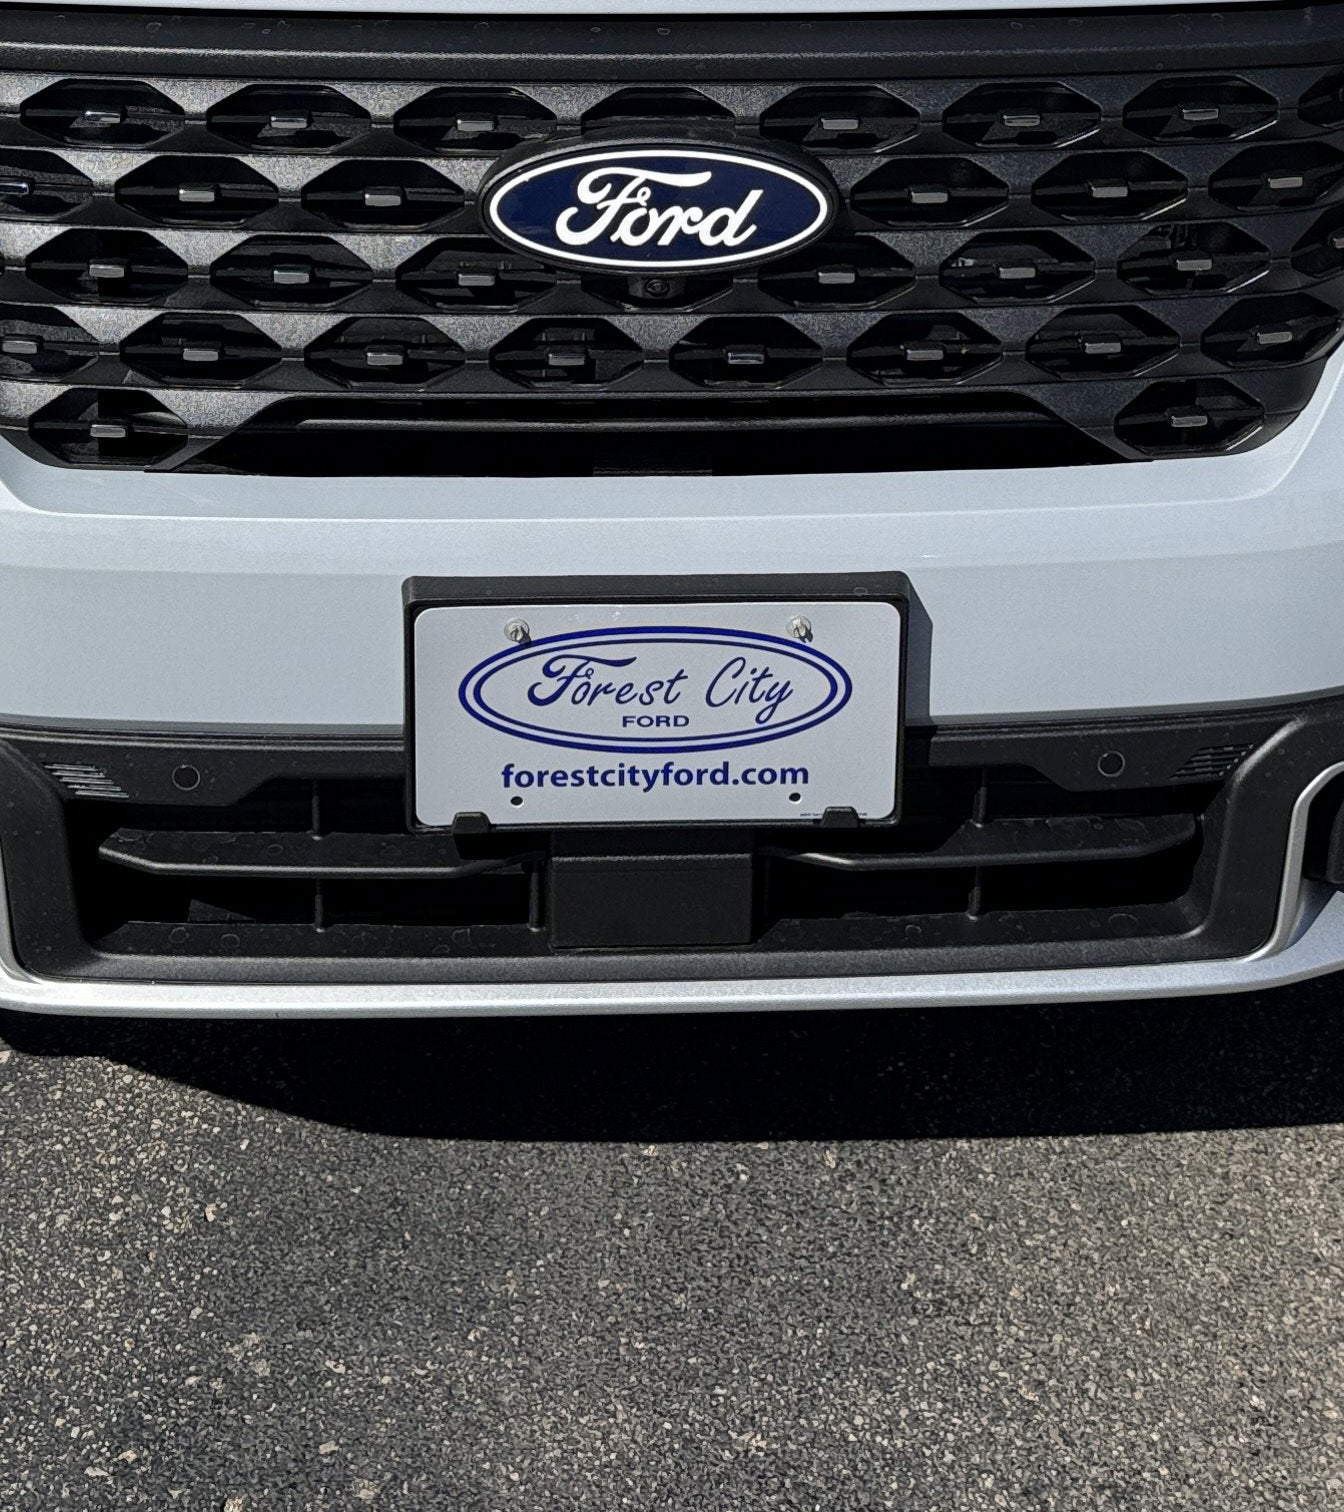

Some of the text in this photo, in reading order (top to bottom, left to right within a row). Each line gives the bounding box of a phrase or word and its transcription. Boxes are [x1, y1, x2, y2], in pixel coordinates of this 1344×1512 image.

[556, 166, 764, 247] Ford
[527, 654, 794, 725] Forest City
[621, 714, 690, 729] FORD
[501, 761, 810, 793] forestcityford.com
